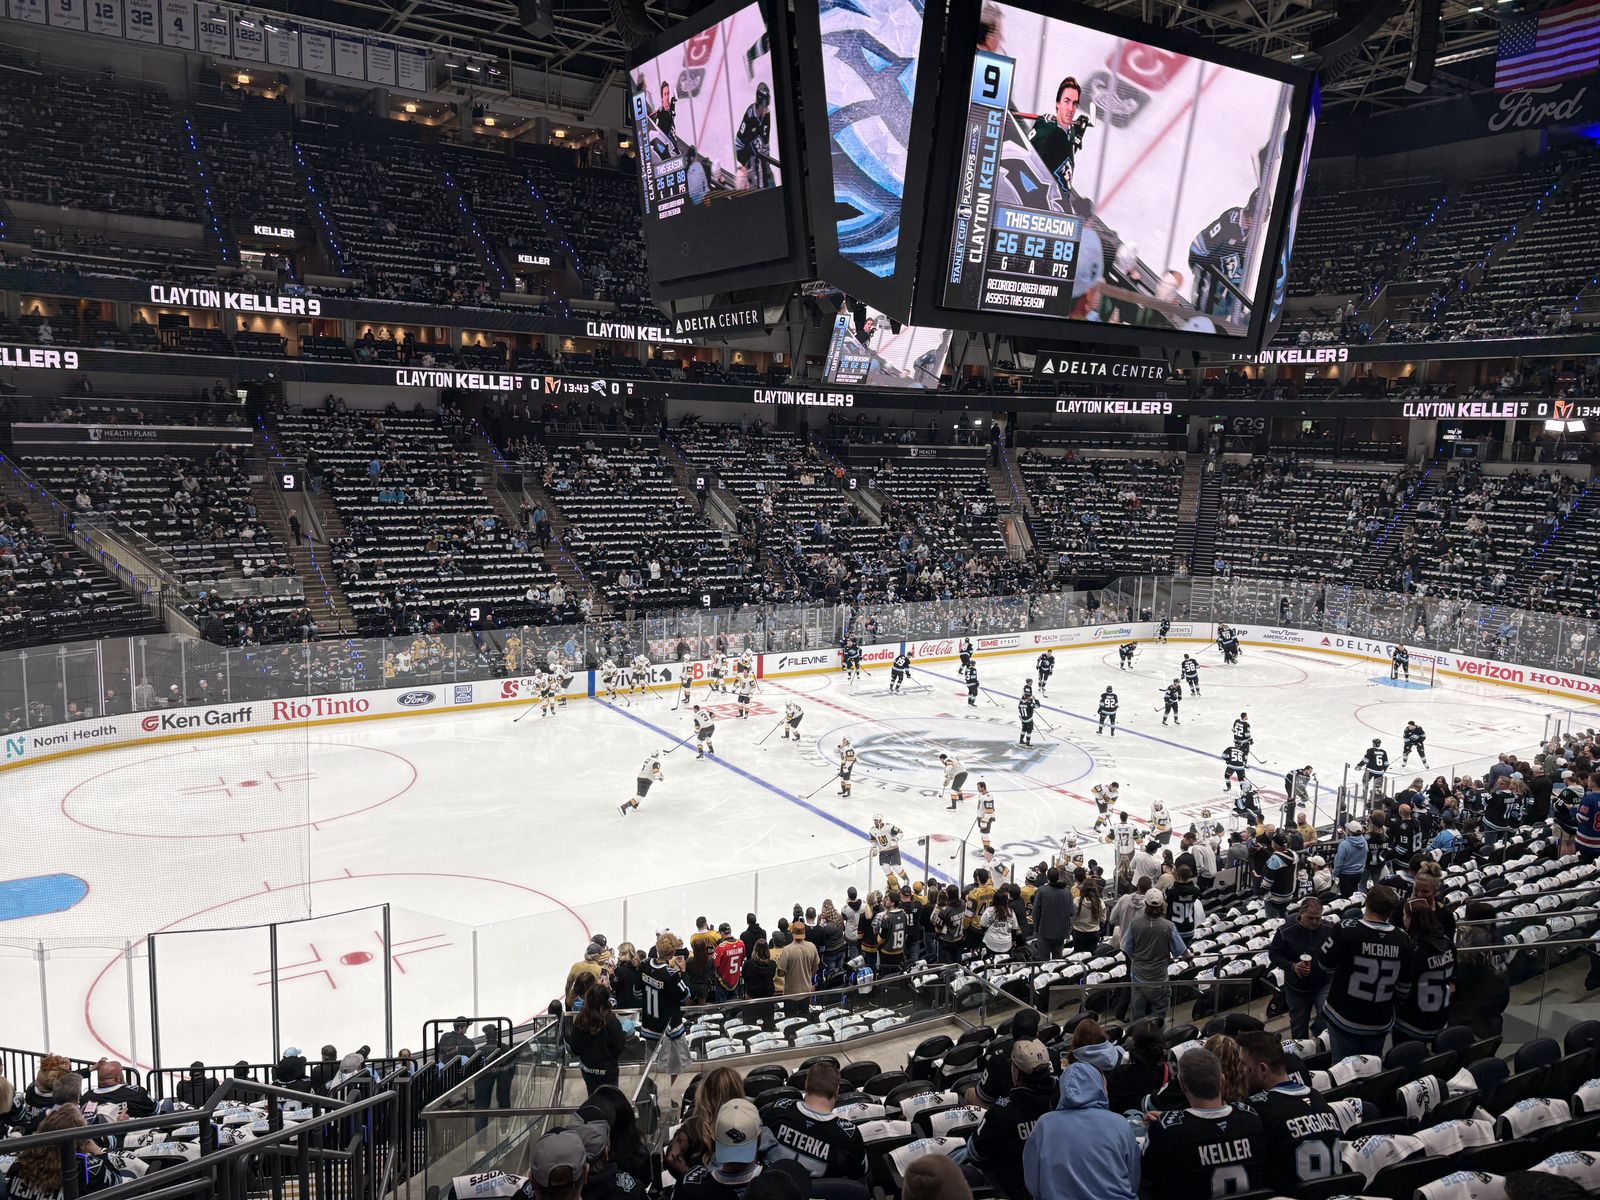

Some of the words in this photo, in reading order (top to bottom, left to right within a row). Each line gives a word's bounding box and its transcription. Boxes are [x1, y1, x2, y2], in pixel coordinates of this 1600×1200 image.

[95, 2, 114, 19] 12
[130, 9, 153, 26] 32
[173, 17, 183, 31] 4
[200, 21, 228, 36] 3051
[235, 28, 263, 41] 1223
[982, 64, 1001, 99] 9
[1488, 83, 1588, 131] Ford
[979, 110, 1002, 190] KELLER
[646, 162, 655, 201] CLAYTON
[952, 242, 964, 283] STANLEY
[958, 221, 968, 240] CUP
[964, 154, 977, 204] PLAYOFFS
[1005, 211, 1030, 230] THIS
[1030, 216, 1075, 237] SEASON
[254, 225, 295, 239] KELLER
[969, 192, 991, 264] CLAYTON
[996, 232, 1018, 254] 26
[1024, 236, 1046, 258] 62
[1052, 240, 1074, 262] 88
[518, 254, 551, 266] KELLER
[1001, 256, 1009, 271] G
[1028, 260, 1035, 274] A
[1051, 263, 1069, 278] PTS
[987, 278, 1017, 293] RECORDED
[1016, 282, 1039, 295] CAREER
[1038, 284, 1052, 296] HIGH
[151, 285, 221, 309] CLAYTON
[224, 291, 306, 316] KELLER
[307, 300, 321, 316] 9
[985, 292, 1010, 306] ASSISTS
[1009, 294, 1022, 307] THIS
[1022, 296, 1046, 309] SEASON
[684, 315, 716, 333] DELTA
[718, 309, 759, 327] CENTER
[838, 316, 846, 326] 9
[586, 321, 635, 340] CLAYTON
[637, 325, 693, 344] KEL
[64, 350, 78, 370] 9
[1276, 349, 1337, 364] KELLER
[1338, 348, 1348, 363] 9
[1058, 360, 1107, 376] DELTA
[1112, 363, 1164, 380] CENTER
[396, 370, 453, 389] CLAYTON
[531, 378, 540, 391] 0
[563, 383, 590, 394] 13:43
[611, 382, 620, 395] 0
[754, 390, 794, 406] CLAYTON
[796, 393, 844, 407] KELLER
[845, 394, 854, 407] 9
[1056, 400, 1101, 413] CLAYTON
[1104, 402, 1161, 415] KELLER
[1163, 402, 1173, 415] 9
[1403, 403, 1455, 418] CLAYTON
[1537, 403, 1548, 416] 0
[104, 429, 132, 438] HEALTH
[133, 430, 157, 438] PLANS
[283, 474, 294, 489] 9
[696, 477, 705, 489] 9
[849, 478, 857, 490] 9
[702, 594, 711, 607] 9
[469, 607, 480, 621] 9
[980, 639, 998, 648] SME
[1263, 634, 1288, 642] AMERICA
[1336, 638, 1382, 655] DELTA
[788, 655, 828, 666] FILEVINE
[1406, 651, 1450, 667] ANDUEL
[1185, 663, 1195, 673] 38
[1455, 659, 1524, 683] verizon
[1530, 672, 1600, 695] HONDA
[404, 692, 428, 704] Ford
[1104, 698, 1116, 708] 92
[272, 700, 311, 720] Rio
[312, 697, 370, 716] Tinto
[1019, 705, 1028, 717] 11
[161, 713, 200, 731] Ken
[204, 706, 252, 726] Garff
[33, 731, 69, 749] Nomi
[73, 724, 117, 741] Health
[1230, 751, 1243, 763] 56
[1376, 754, 1383, 767] 6
[1171, 901, 1194, 924] 94
[893, 930, 905, 950] 19
[1362, 942, 1400, 958] MCBAIN
[729, 955, 740, 975] 5
[1347, 955, 1401, 1003] 22
[645, 984, 659, 1019] 11
[777, 1123, 831, 1161] PETERKA
[1198, 1137, 1252, 1166] KELLER
